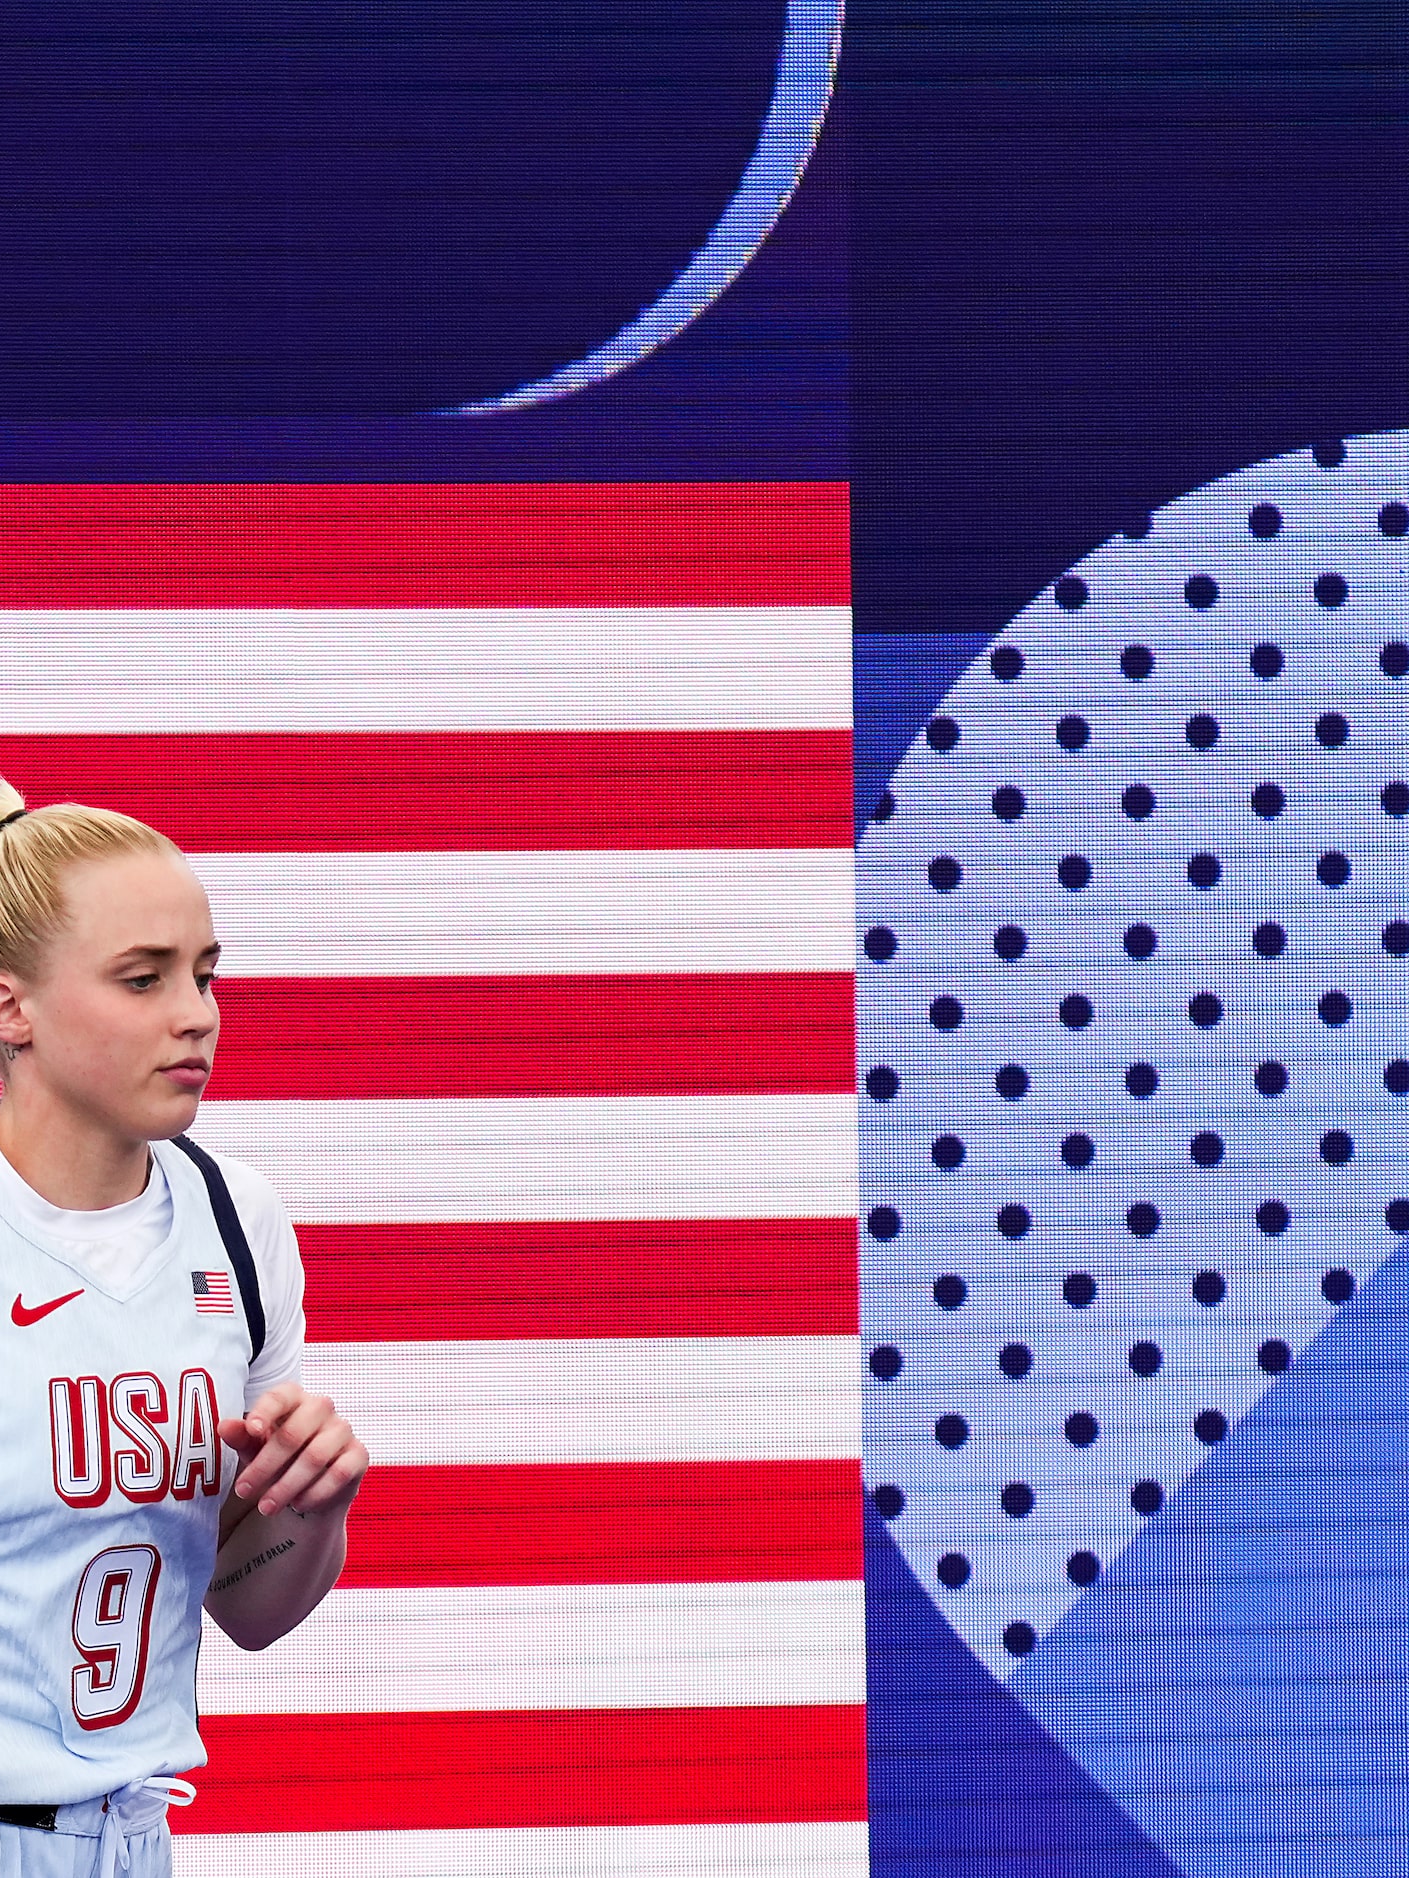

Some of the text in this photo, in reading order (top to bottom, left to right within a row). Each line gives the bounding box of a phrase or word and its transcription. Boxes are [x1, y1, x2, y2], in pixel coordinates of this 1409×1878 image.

[49, 1367, 222, 1508] USA
[214, 1568, 243, 1592] JOURNEY
[244, 1562, 252, 1575] IS
[252, 1553, 267, 1569] THE
[266, 1538, 296, 1560] DREAM
[72, 1544, 161, 1731] 9
